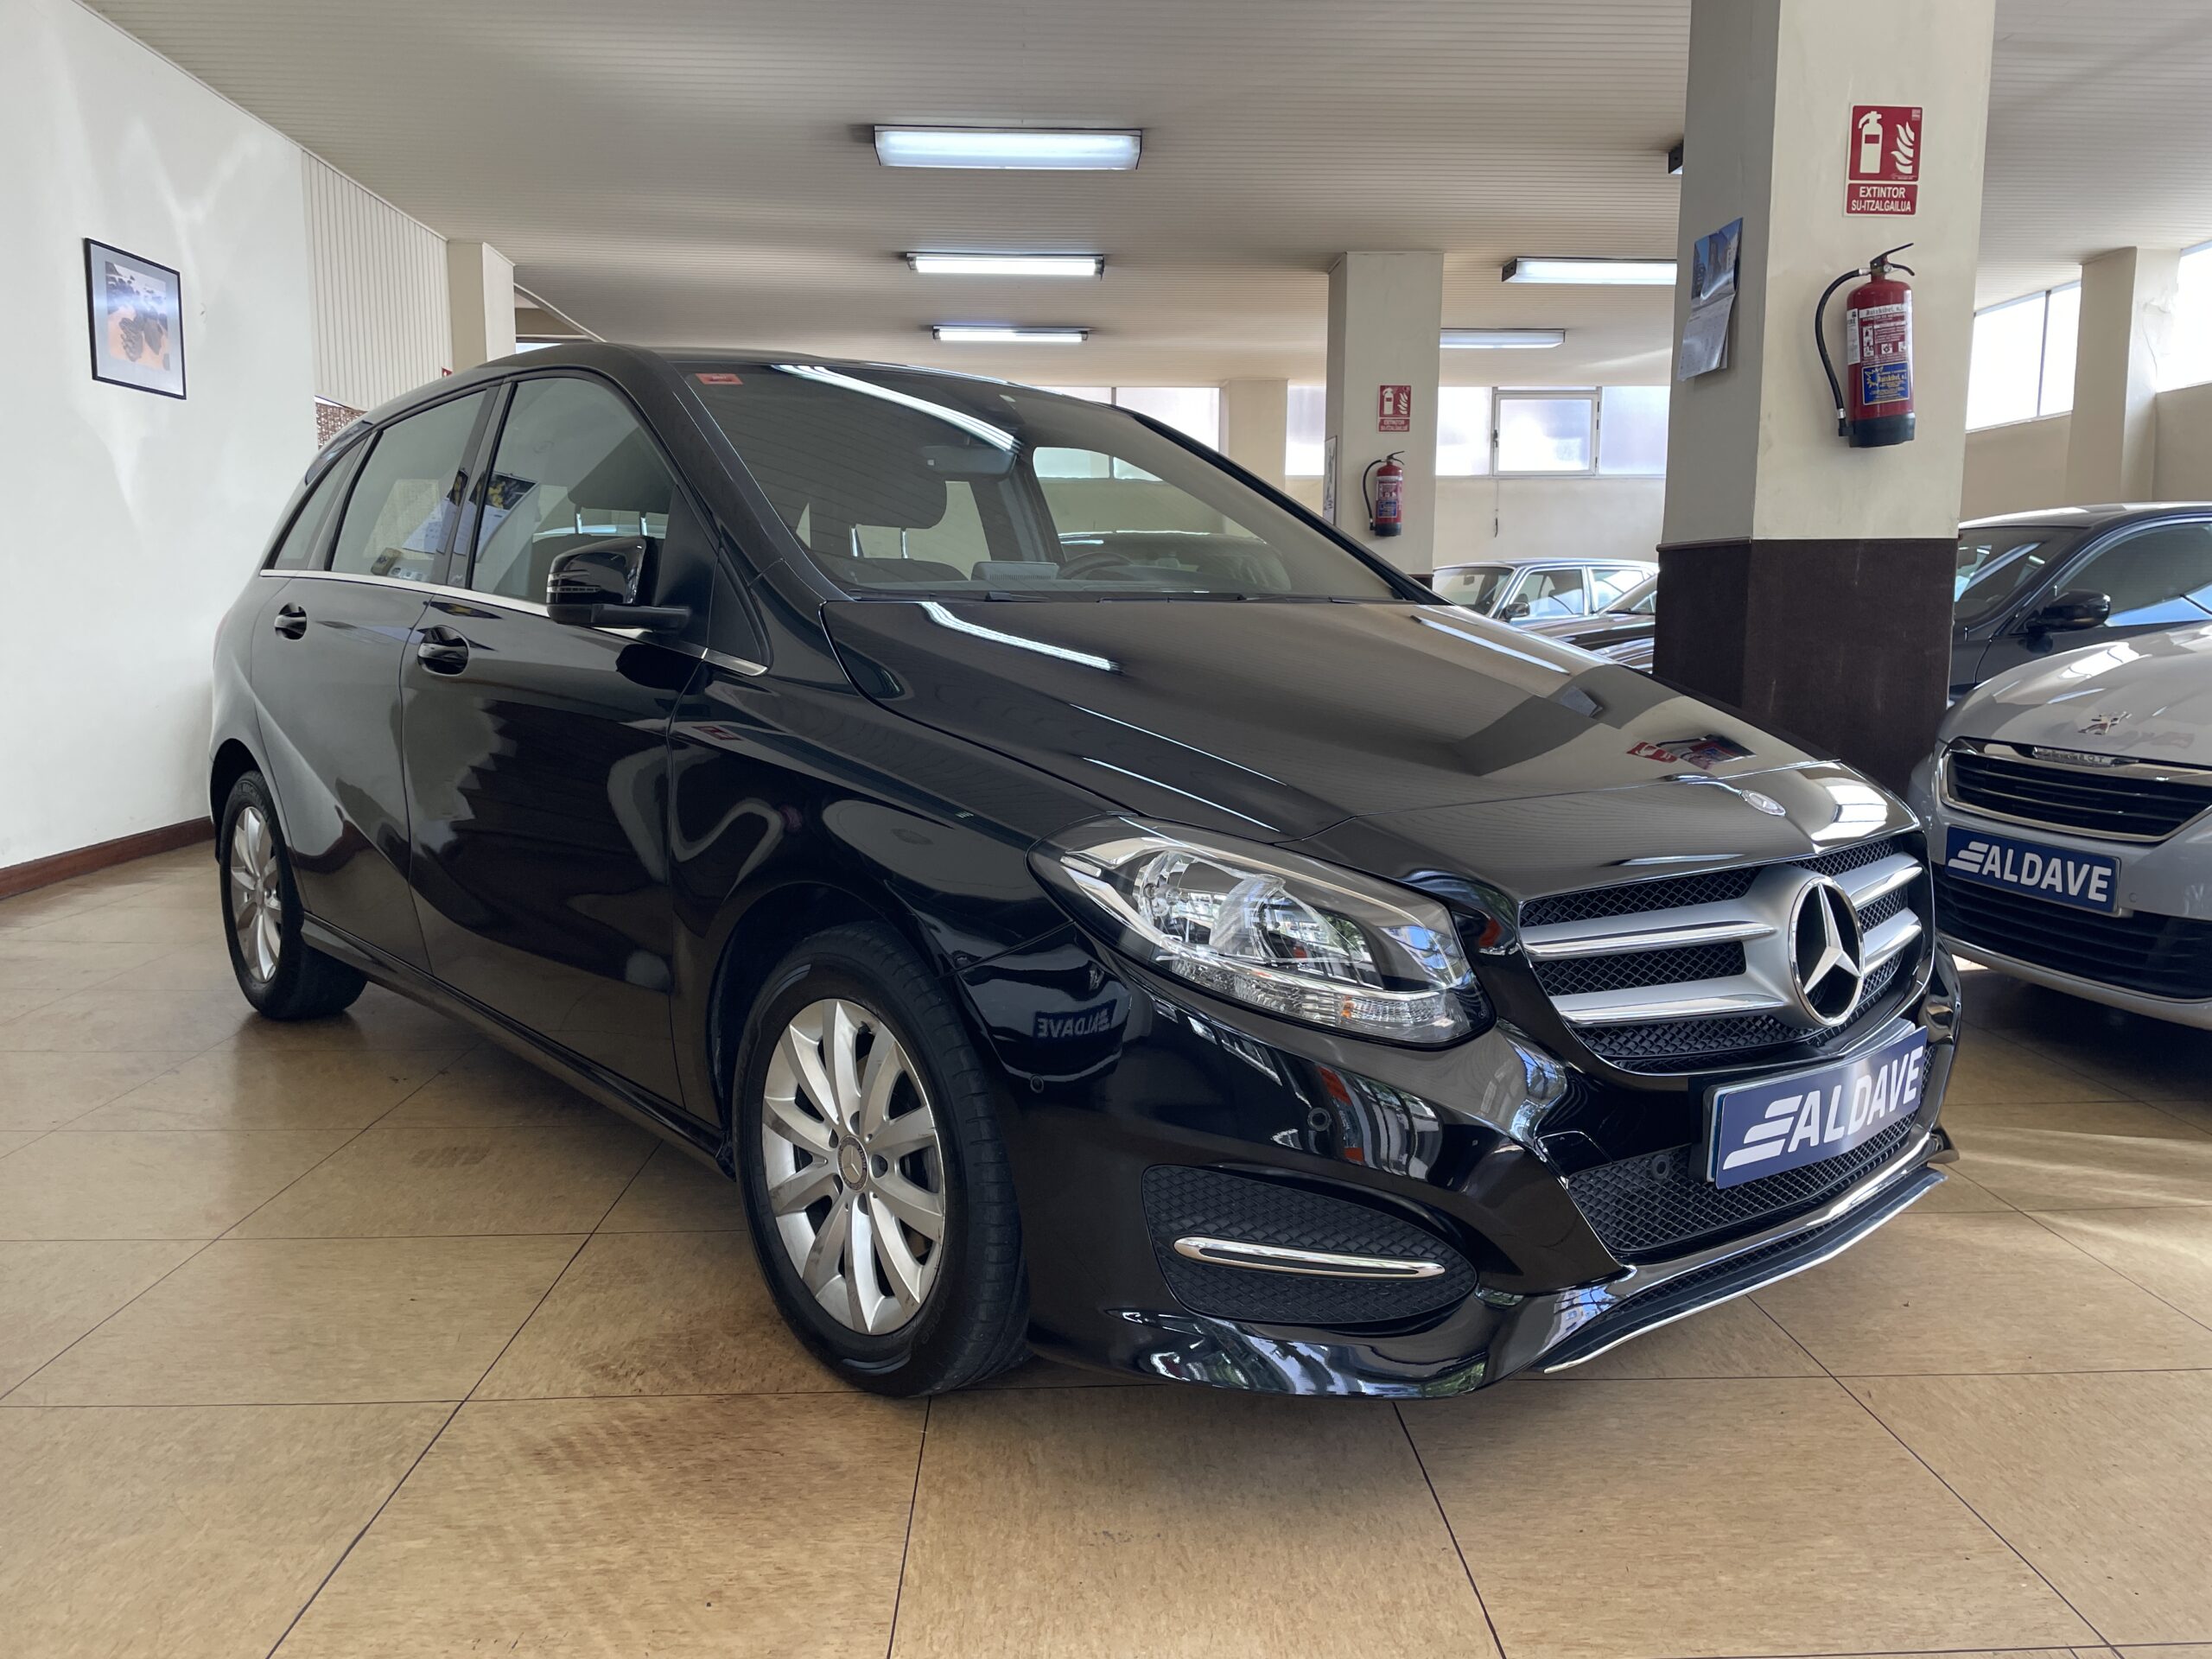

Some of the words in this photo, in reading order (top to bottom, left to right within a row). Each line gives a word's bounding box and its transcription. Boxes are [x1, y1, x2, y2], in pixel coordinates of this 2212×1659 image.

[1851, 200, 1911, 212] SU-ITZALGAILUA
[1859, 186, 1906, 198] EXTINTOR
[1981, 845, 2112, 902] ALDAVE
[1788, 1046, 1923, 1153] ALDAVE
